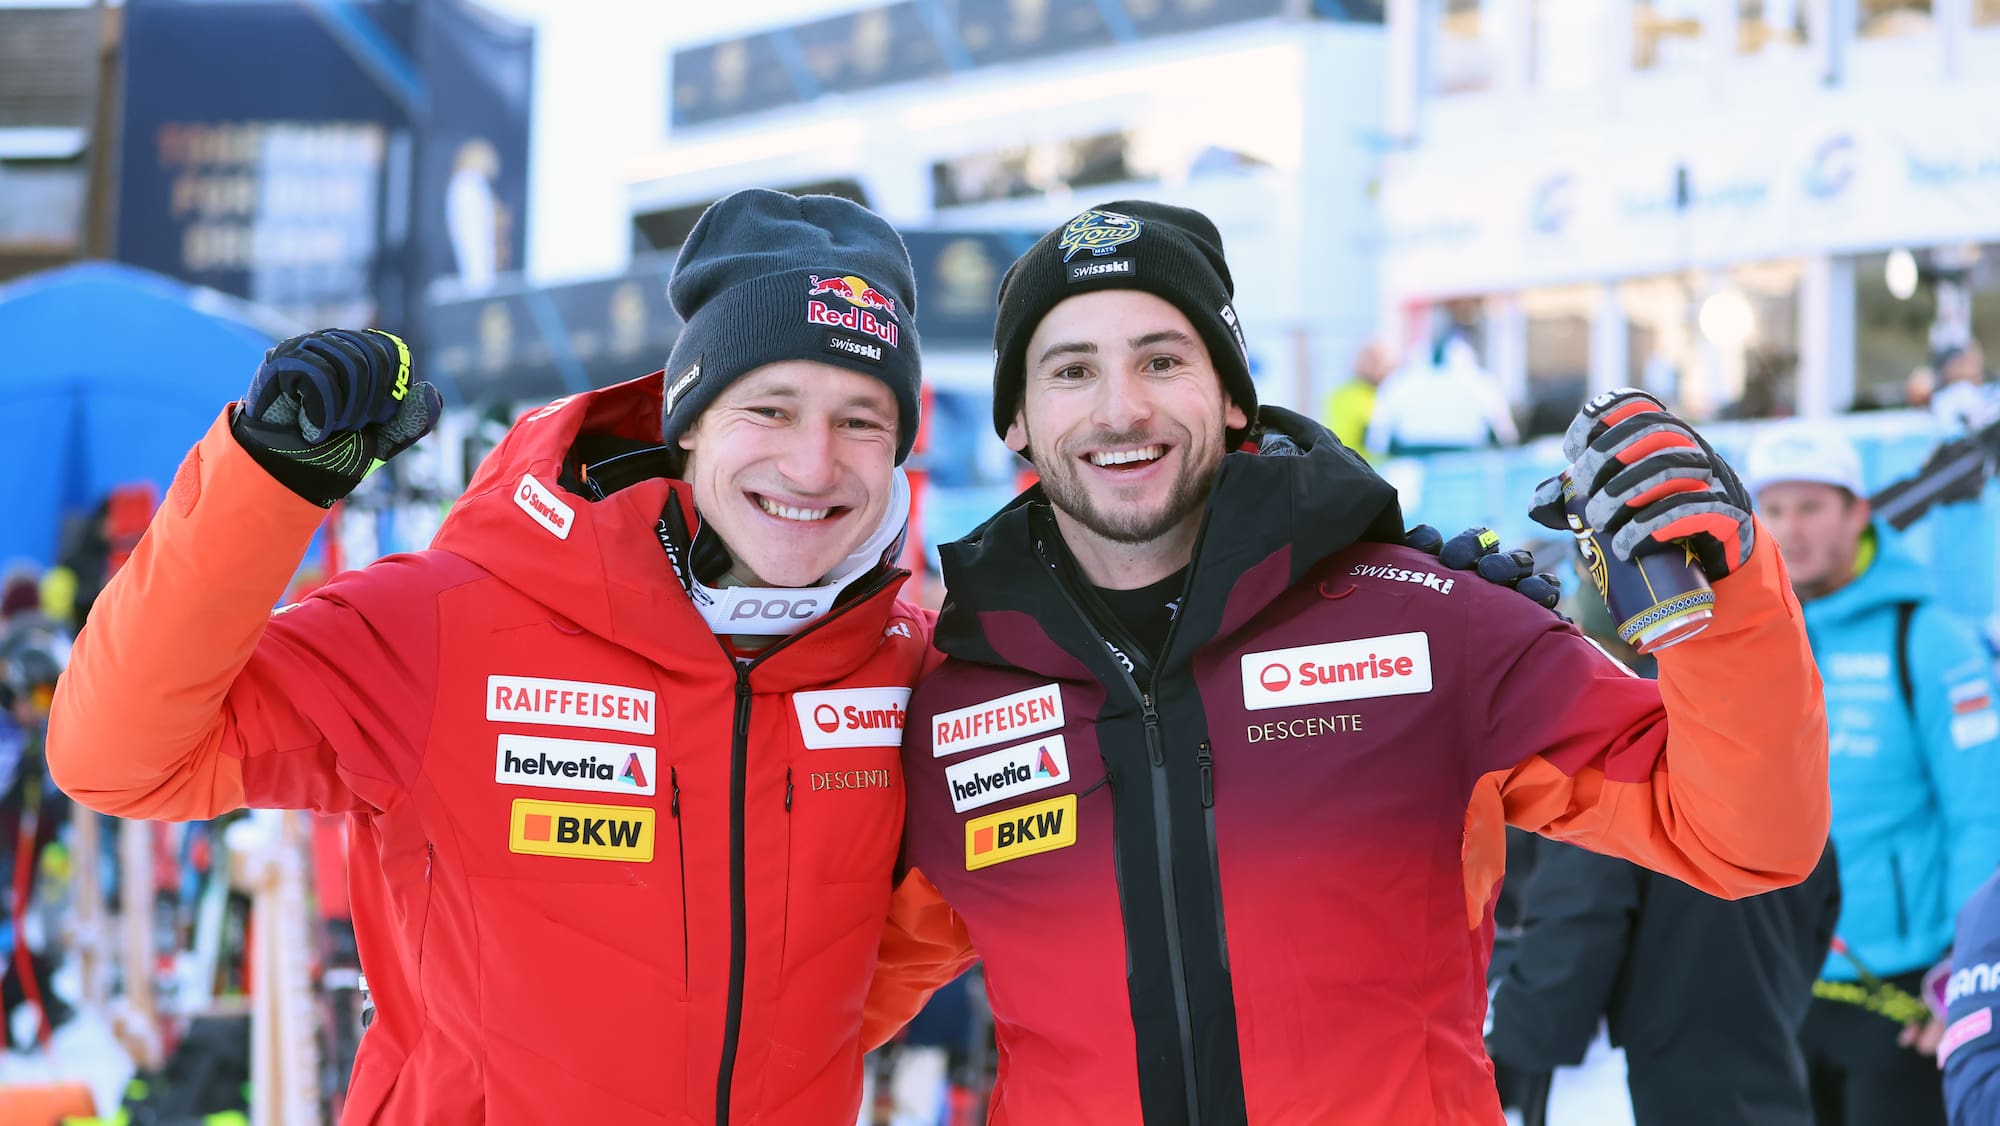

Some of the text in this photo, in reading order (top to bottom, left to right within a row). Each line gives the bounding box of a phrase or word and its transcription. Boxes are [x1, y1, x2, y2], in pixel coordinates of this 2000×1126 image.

[1073, 260, 1129, 277] swissski
[808, 300, 898, 349] Red Bull
[829, 338, 882, 361] swissski
[529, 493, 565, 529] Sunrise
[1350, 563, 1456, 595] swissski
[1299, 653, 1414, 686] Sunrise
[495, 686, 649, 723] RAIFFEISEN
[843, 702, 907, 730] Sunris
[937, 695, 1056, 746] RAIFFEISEN
[1246, 713, 1363, 744] DESCENTE
[504, 750, 614, 781] helvetia
[952, 761, 1031, 801] helvetia
[556, 816, 642, 848] BKW
[997, 808, 1064, 848] BKW
